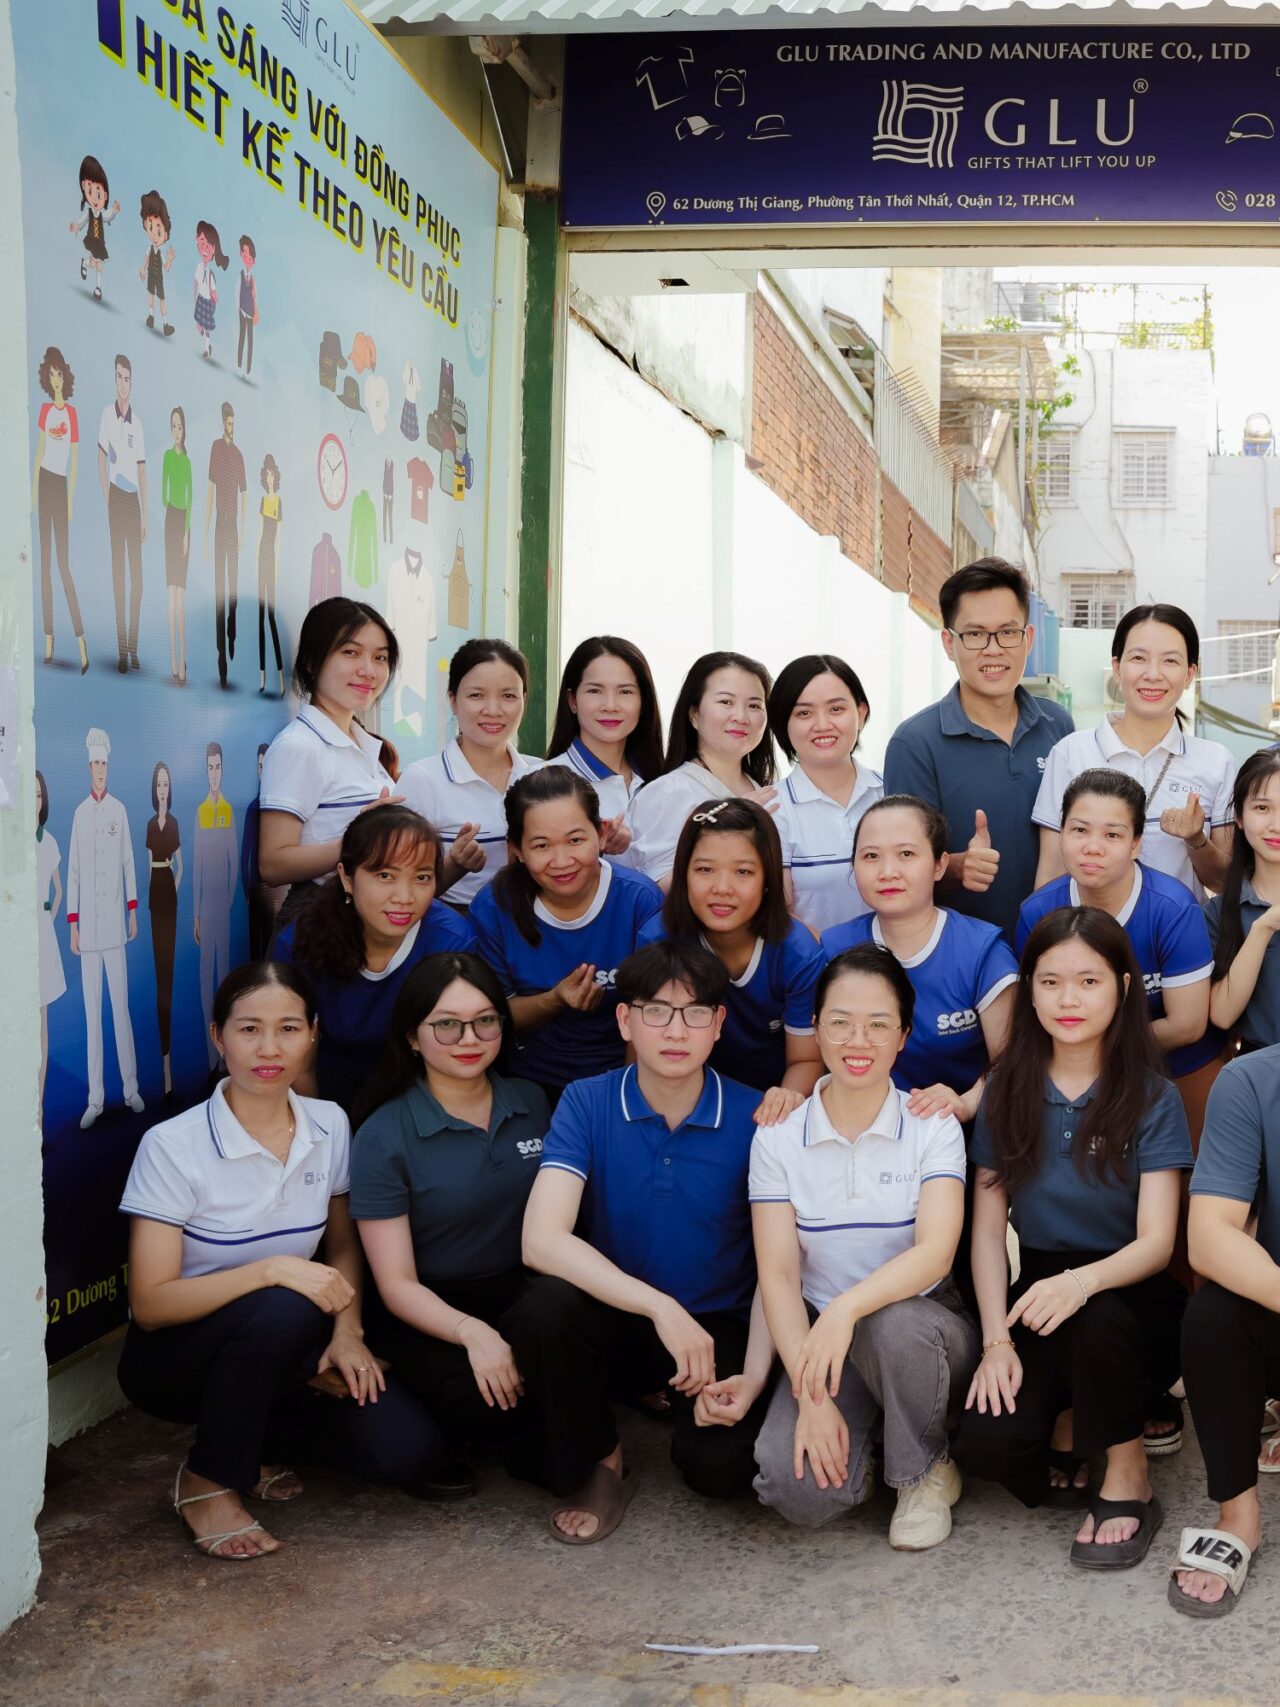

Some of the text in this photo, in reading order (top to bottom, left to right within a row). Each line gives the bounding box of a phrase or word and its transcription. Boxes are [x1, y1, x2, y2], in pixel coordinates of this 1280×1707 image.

[315, 16, 357, 82] GLU
[776, 41, 1251, 64] GLU TRADING AND MANUFACTURE CO., LTD
[216, 6, 297, 116] SÁNG
[306, 87, 347, 162] VỚI
[353, 134, 410, 217] ĐỒNG
[415, 192, 461, 264] PHỤC
[983, 97, 1136, 148] GLU
[967, 155, 1157, 170] GIFTS THAT LIFT YOU UP
[241, 106, 291, 187] KẾ
[293, 150, 365, 250] THEO
[372, 217, 415, 290] YÊU
[420, 261, 459, 325] CẦU
[673, 192, 1076, 213] 62 Dương Thị Giang, Phường Tân Thới Nhất, Quận 12, TP.HCM
[1245, 193, 1276, 209] 028
[936, 1008, 977, 1030] SGD
[66, 1274, 118, 1316] Dương
